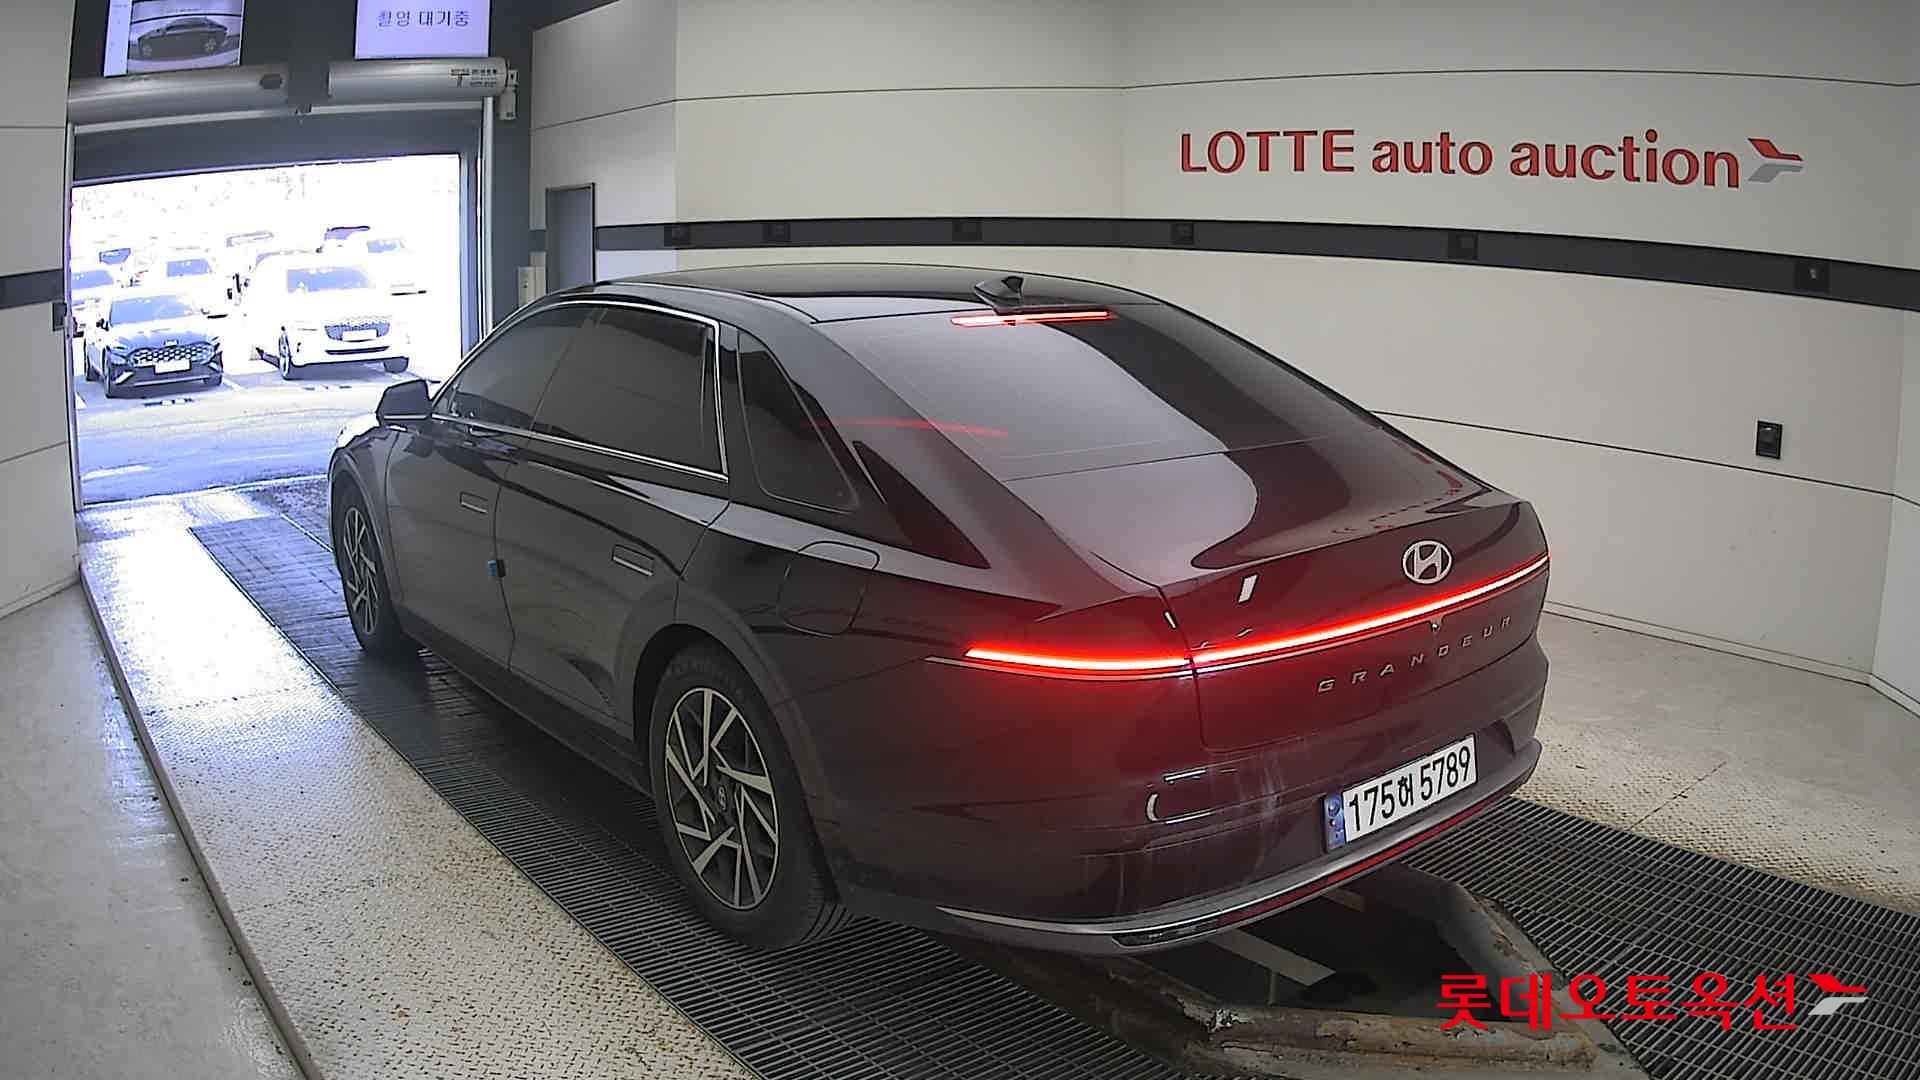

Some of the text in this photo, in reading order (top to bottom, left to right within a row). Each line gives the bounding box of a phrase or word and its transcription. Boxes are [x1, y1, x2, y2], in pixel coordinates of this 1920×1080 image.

[419, 10, 469, 27] 대기중
[1181, 129, 1741, 188] LOTTE auto auction
[1317, 616, 1511, 694] GRANDEUR
